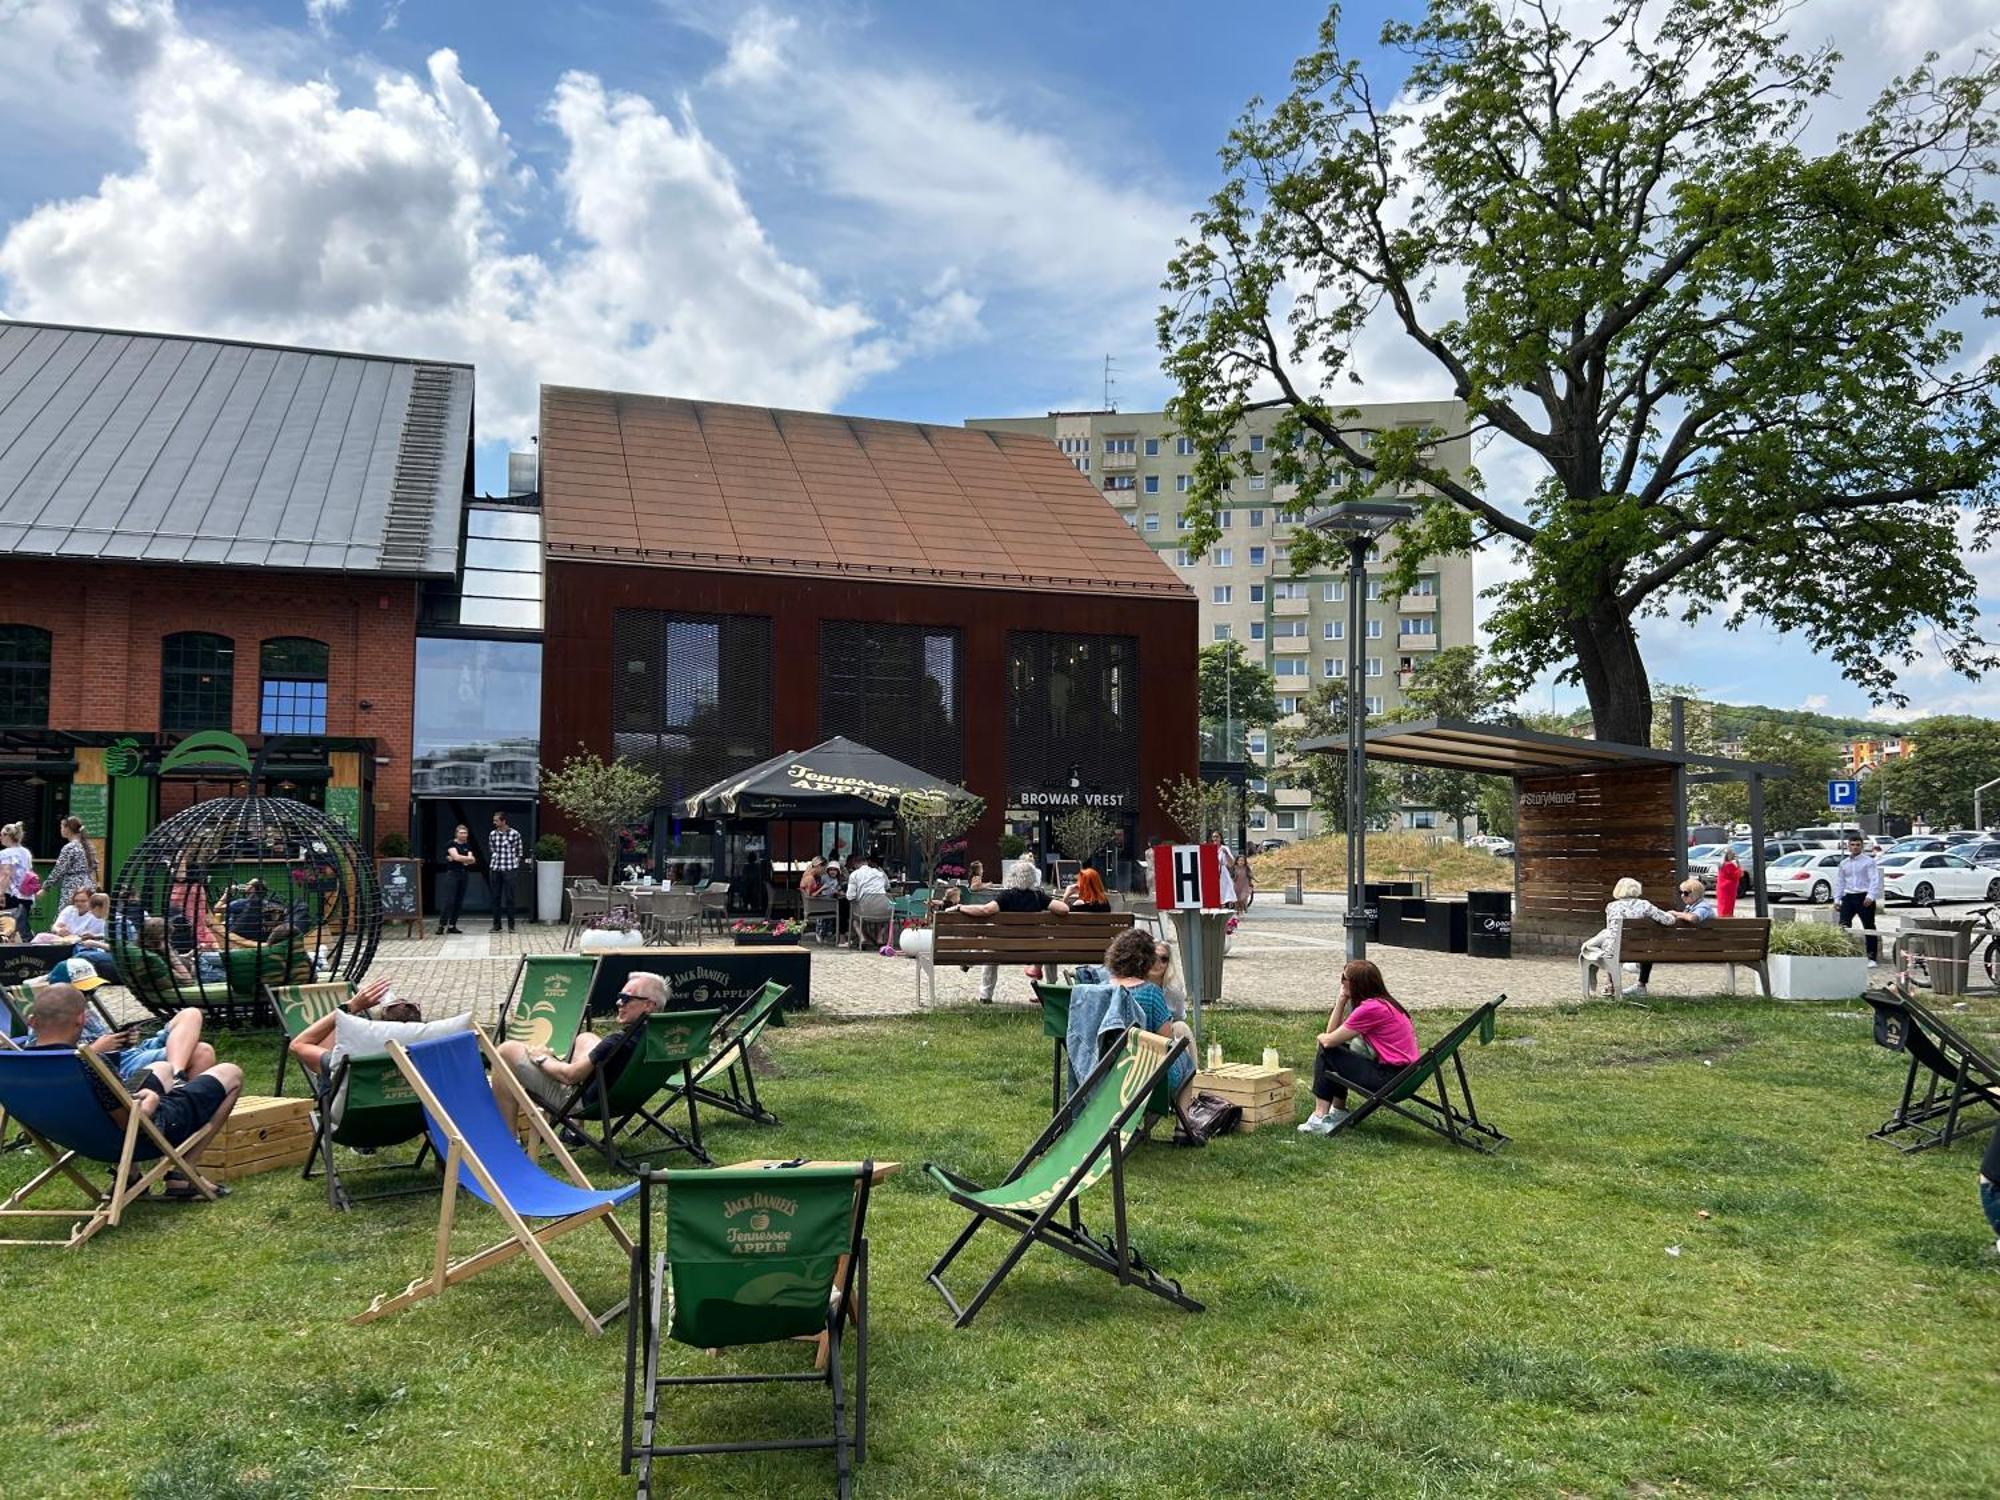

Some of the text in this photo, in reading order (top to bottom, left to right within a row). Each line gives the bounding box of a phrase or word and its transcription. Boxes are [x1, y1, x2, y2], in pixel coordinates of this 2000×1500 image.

[788, 765, 901, 794] Tennessee
[790, 780, 890, 807] APPLE
[1021, 793, 1124, 806] BROWAR VREST
[1834, 783, 1850, 802] P
[1174, 851, 1201, 902] H
[675, 970, 697, 987] JACK
[697, 966, 729, 986] DANIEL'S
[724, 1192, 799, 1218] JACK DANIEL'S
[727, 1227, 792, 1243] Tennessee
[732, 1242, 787, 1253] APPLE
